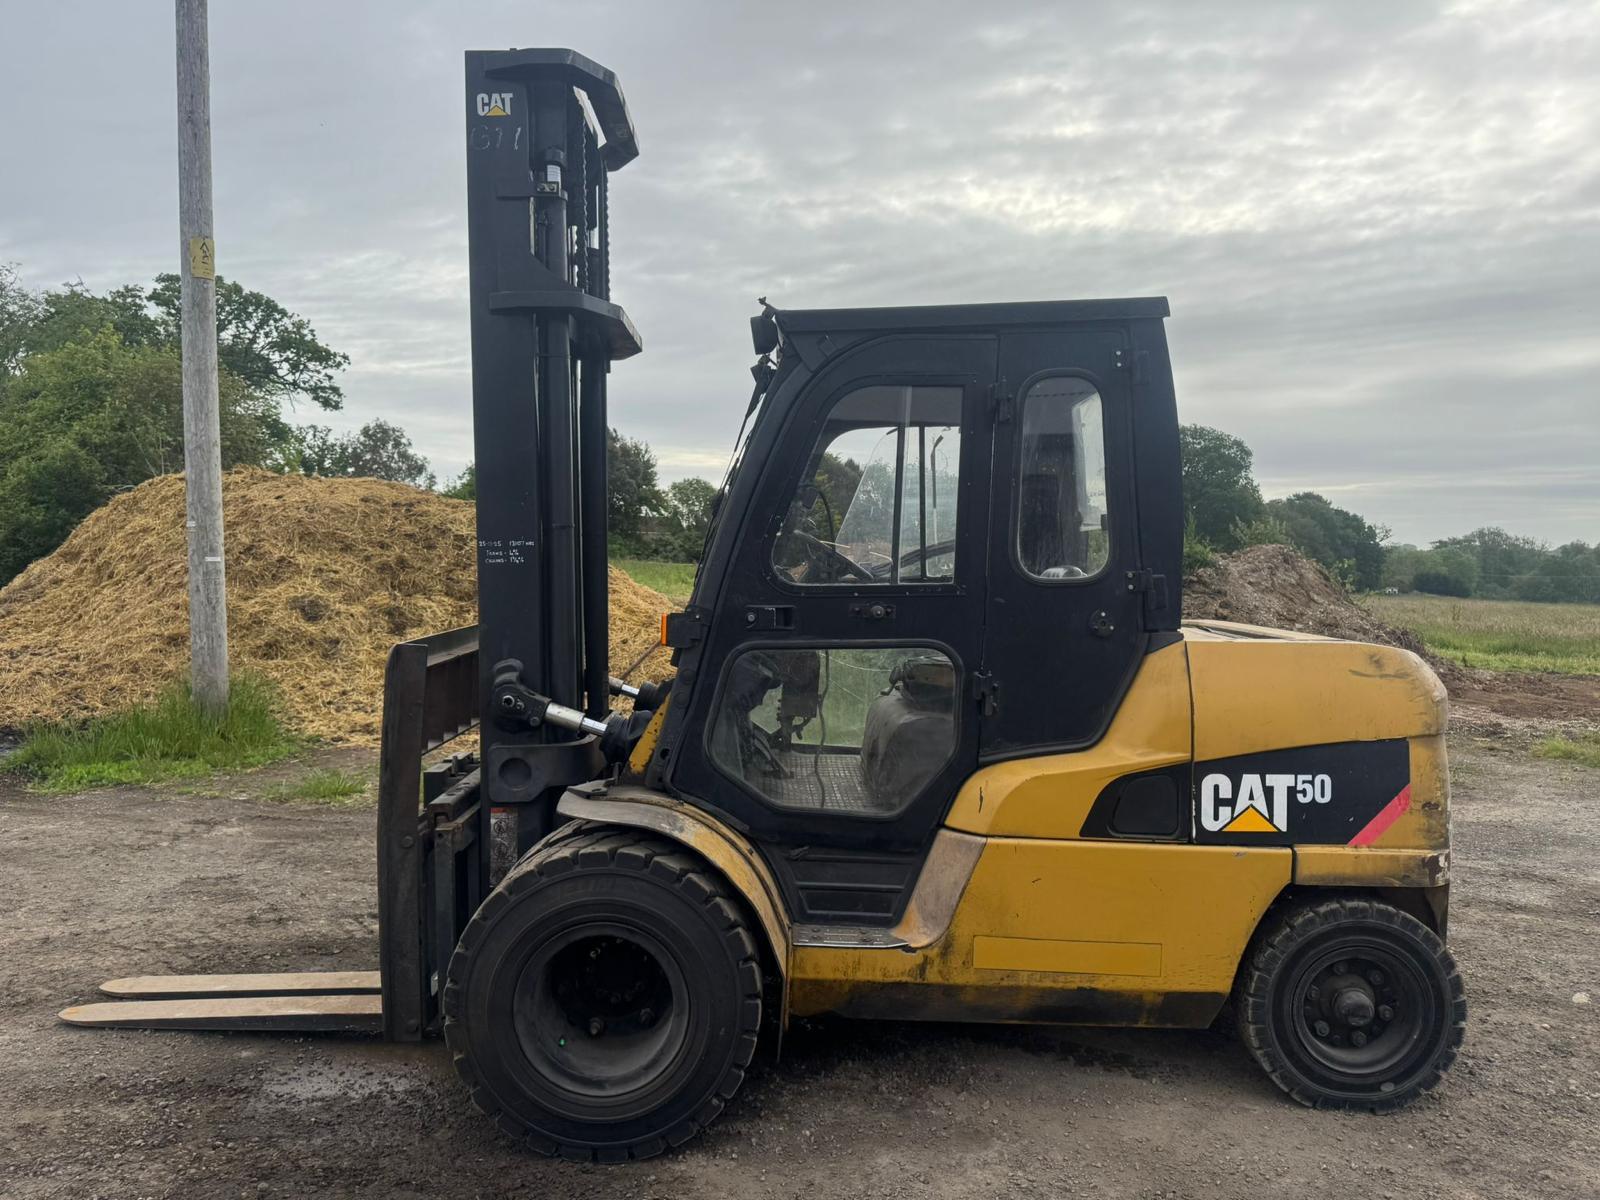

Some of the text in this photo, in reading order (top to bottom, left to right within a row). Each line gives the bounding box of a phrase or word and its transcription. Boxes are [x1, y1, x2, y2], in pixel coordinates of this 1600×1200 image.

[477, 93, 513, 116] CAT
[1201, 773, 1332, 832] CAT 50
